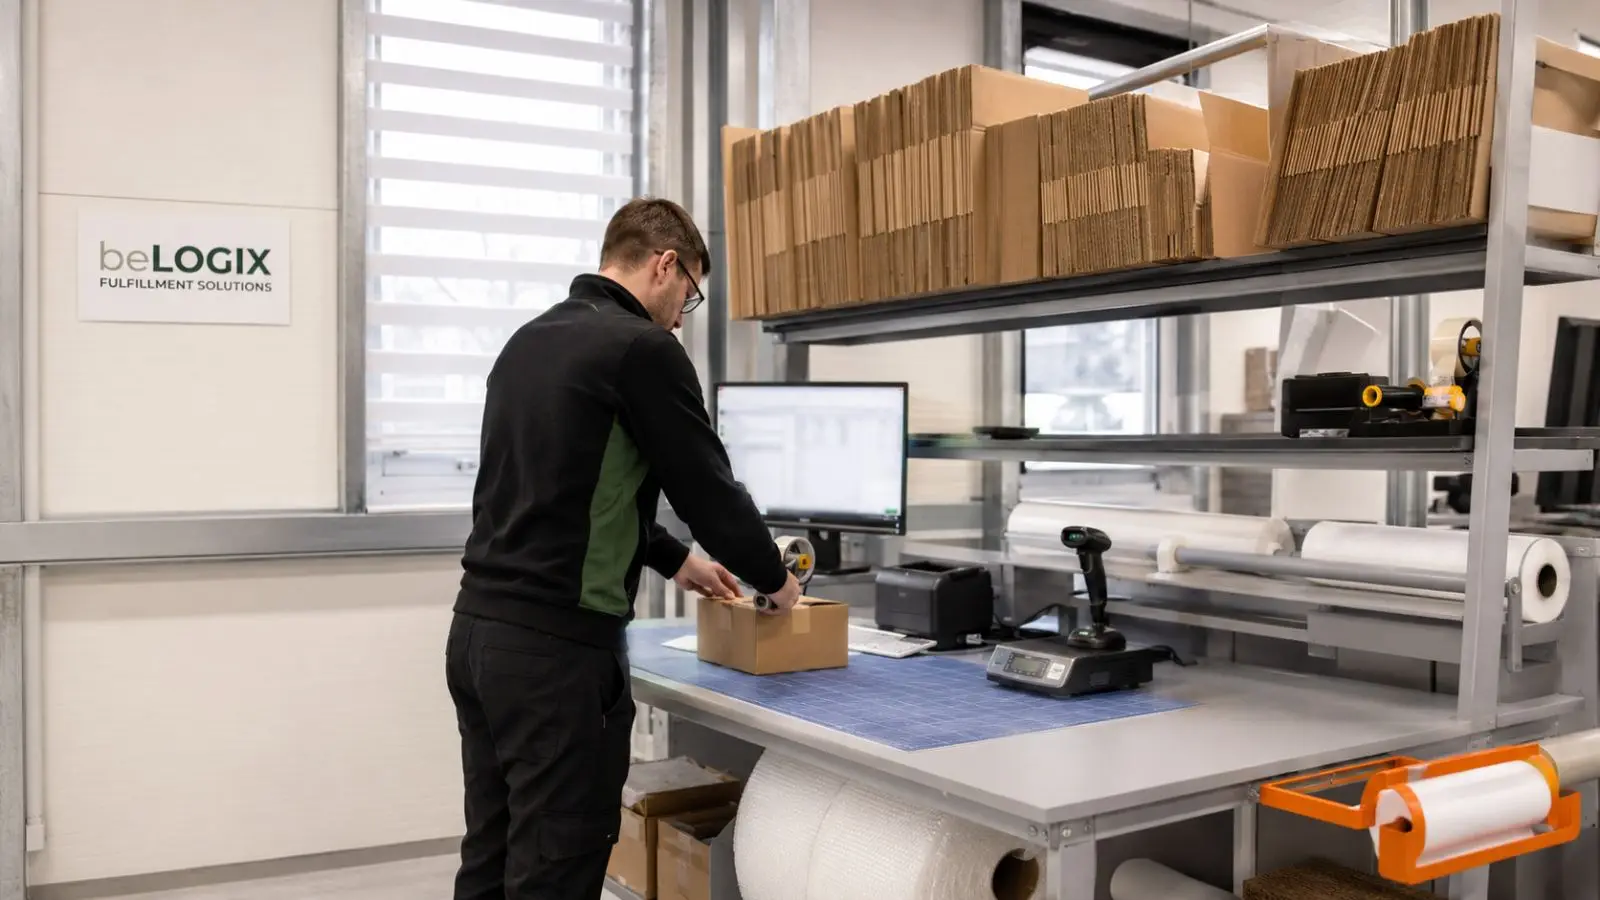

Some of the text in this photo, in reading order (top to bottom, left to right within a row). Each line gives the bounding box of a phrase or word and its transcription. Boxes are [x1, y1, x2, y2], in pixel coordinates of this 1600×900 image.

[99, 240, 272, 276] beLOGIX
[99, 277, 272, 292] FULFILLMENT SOLUTIONS
